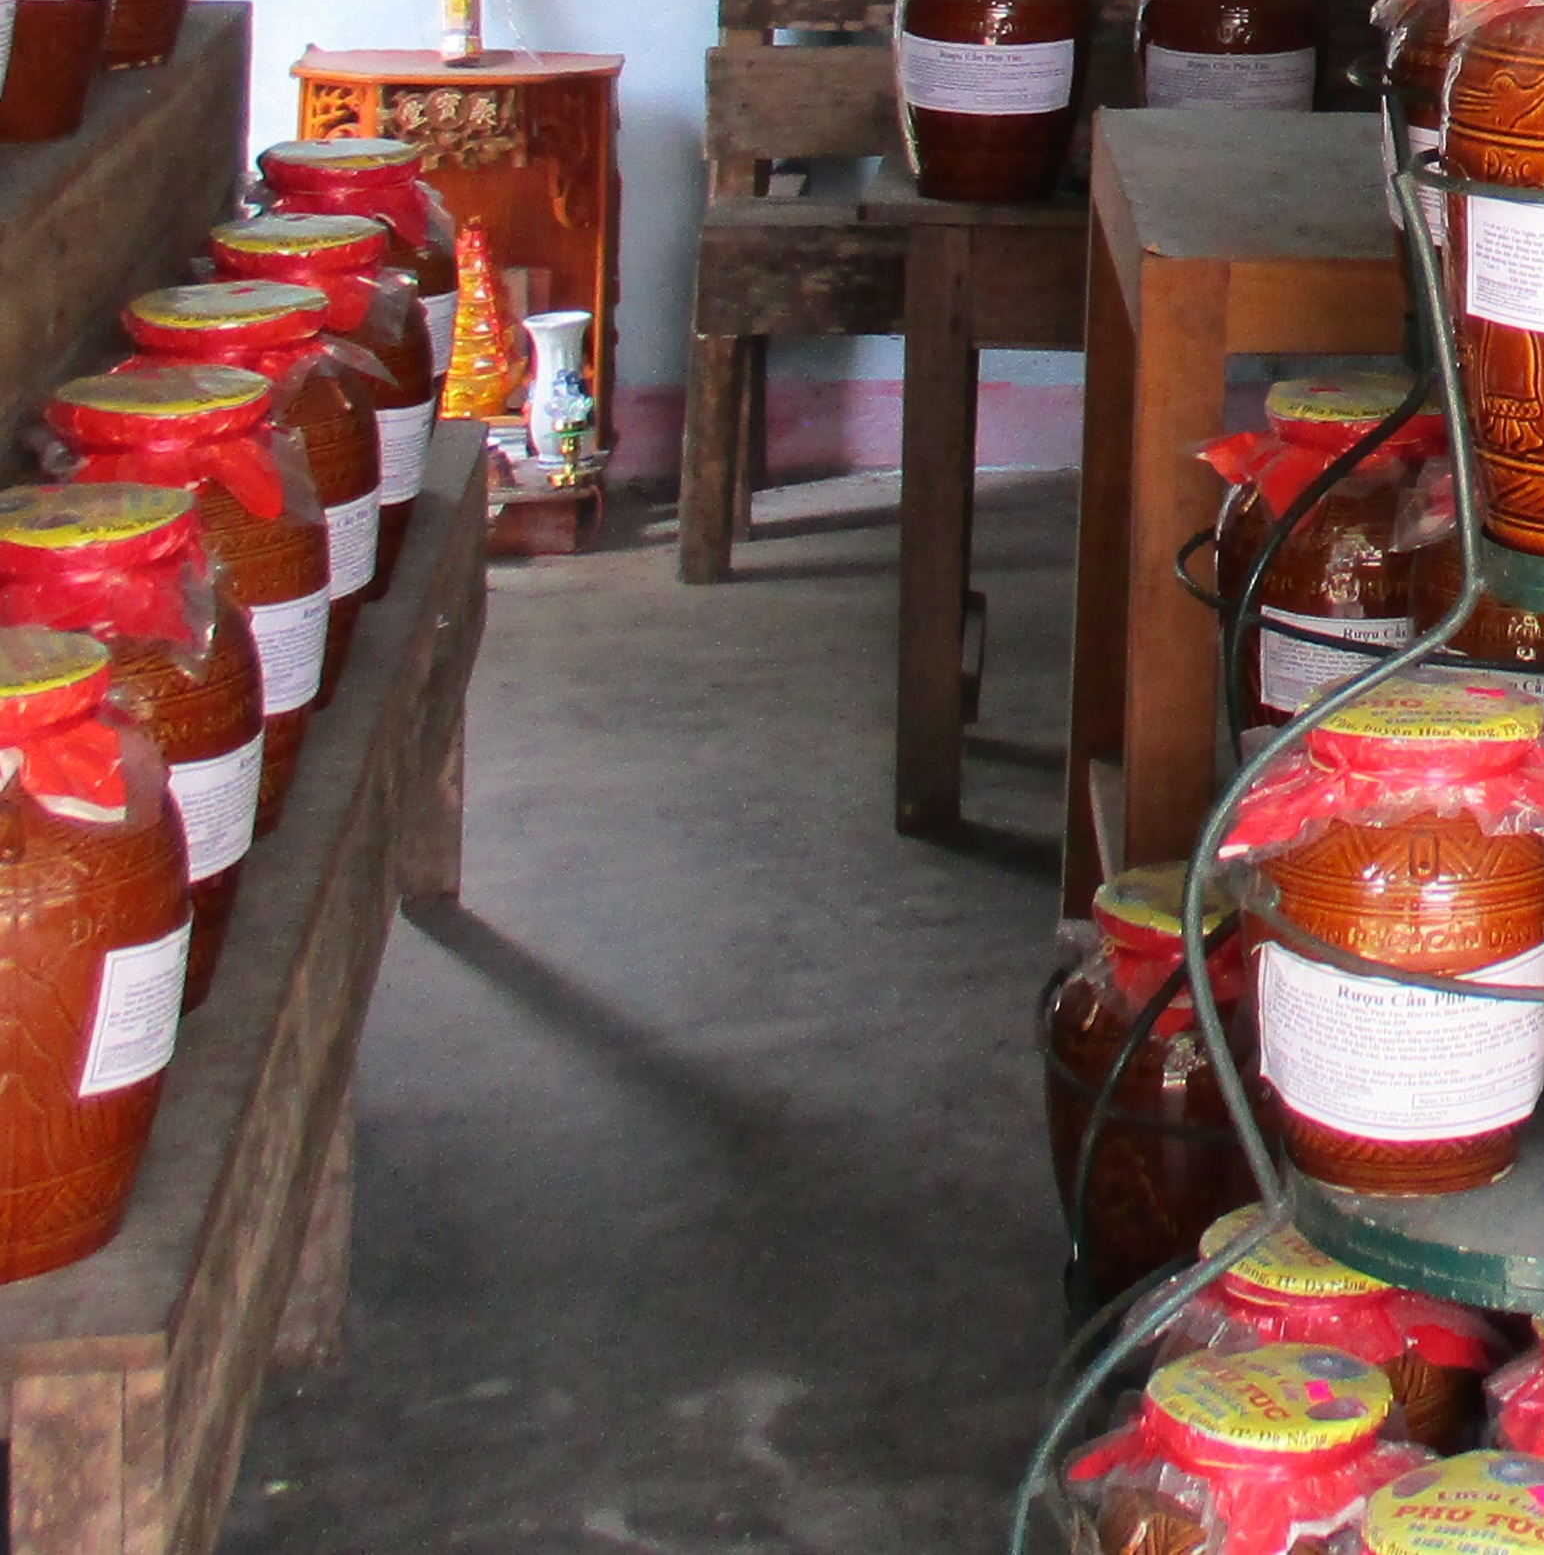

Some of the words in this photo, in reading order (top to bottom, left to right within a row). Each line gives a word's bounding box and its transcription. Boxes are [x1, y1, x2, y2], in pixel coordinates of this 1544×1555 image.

[1362, 723, 1412, 738] huyện
[1337, 983, 1384, 1007] Rượu
[1390, 990, 1427, 1007] Cần
[1286, 1430, 1328, 1447] Nẵng
